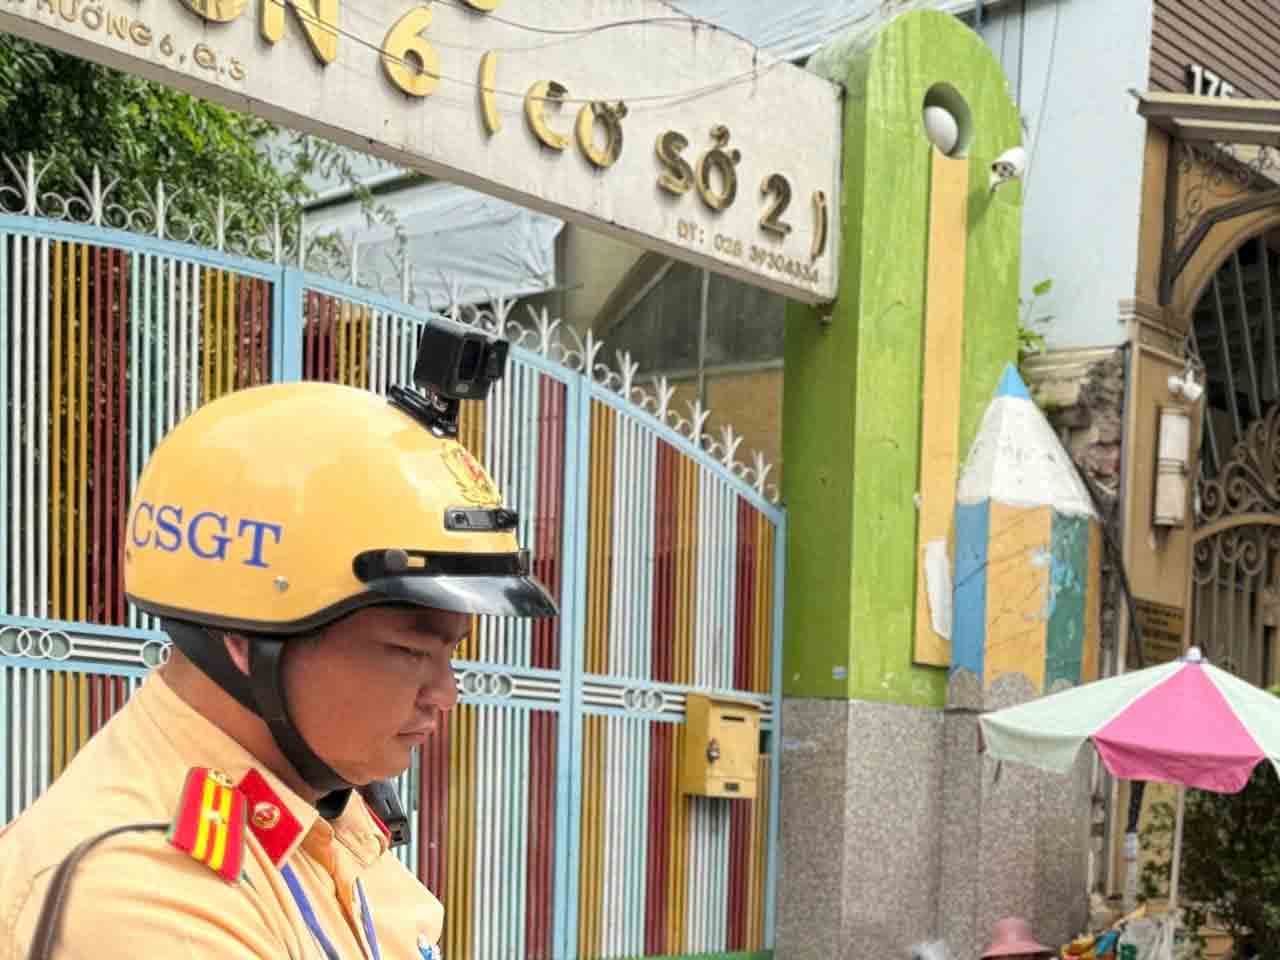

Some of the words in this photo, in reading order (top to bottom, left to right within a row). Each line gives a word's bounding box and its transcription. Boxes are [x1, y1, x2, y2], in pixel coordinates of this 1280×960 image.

[192, 42, 249, 81] Q.3
[380, 6, 441, 97] 6
[655, 125, 741, 211] SỞ
[132, 501, 282, 569] CSGT
